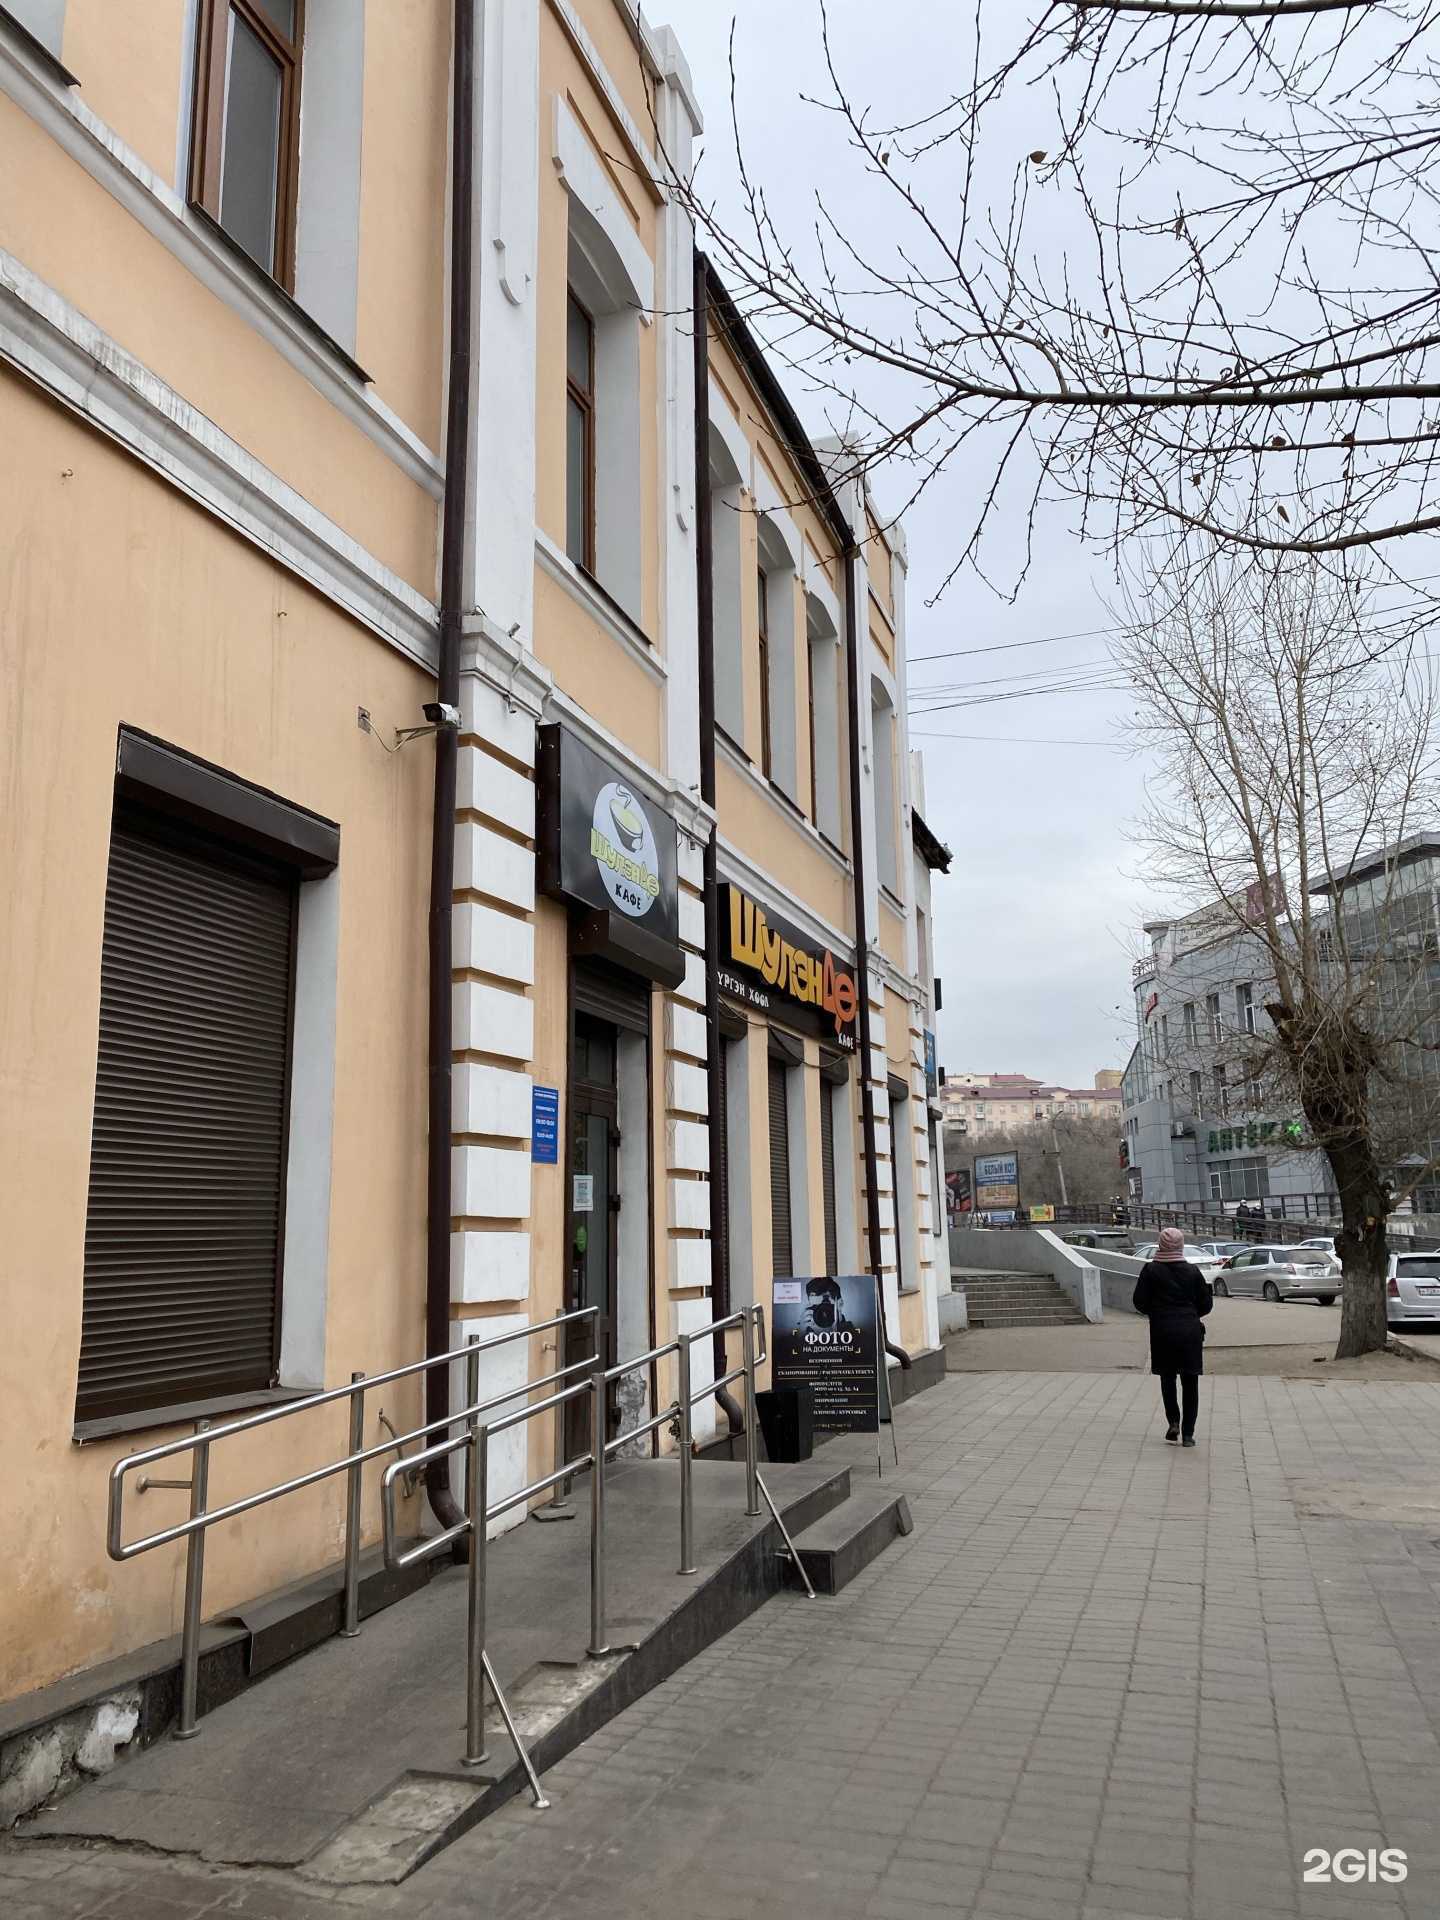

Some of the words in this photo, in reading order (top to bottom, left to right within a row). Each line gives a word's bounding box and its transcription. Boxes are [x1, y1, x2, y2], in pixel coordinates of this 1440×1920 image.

[615, 883, 642, 910] КАФЕ
[838, 1032, 855, 1050] КАФЕ
[1207, 1120, 1295, 1153] АПТЕК
[804, 1331, 853, 1345] ФОТО
[802, 1345, 813, 1353] НА
[813, 1345, 854, 1353] ДОКУМЕНТЫ
